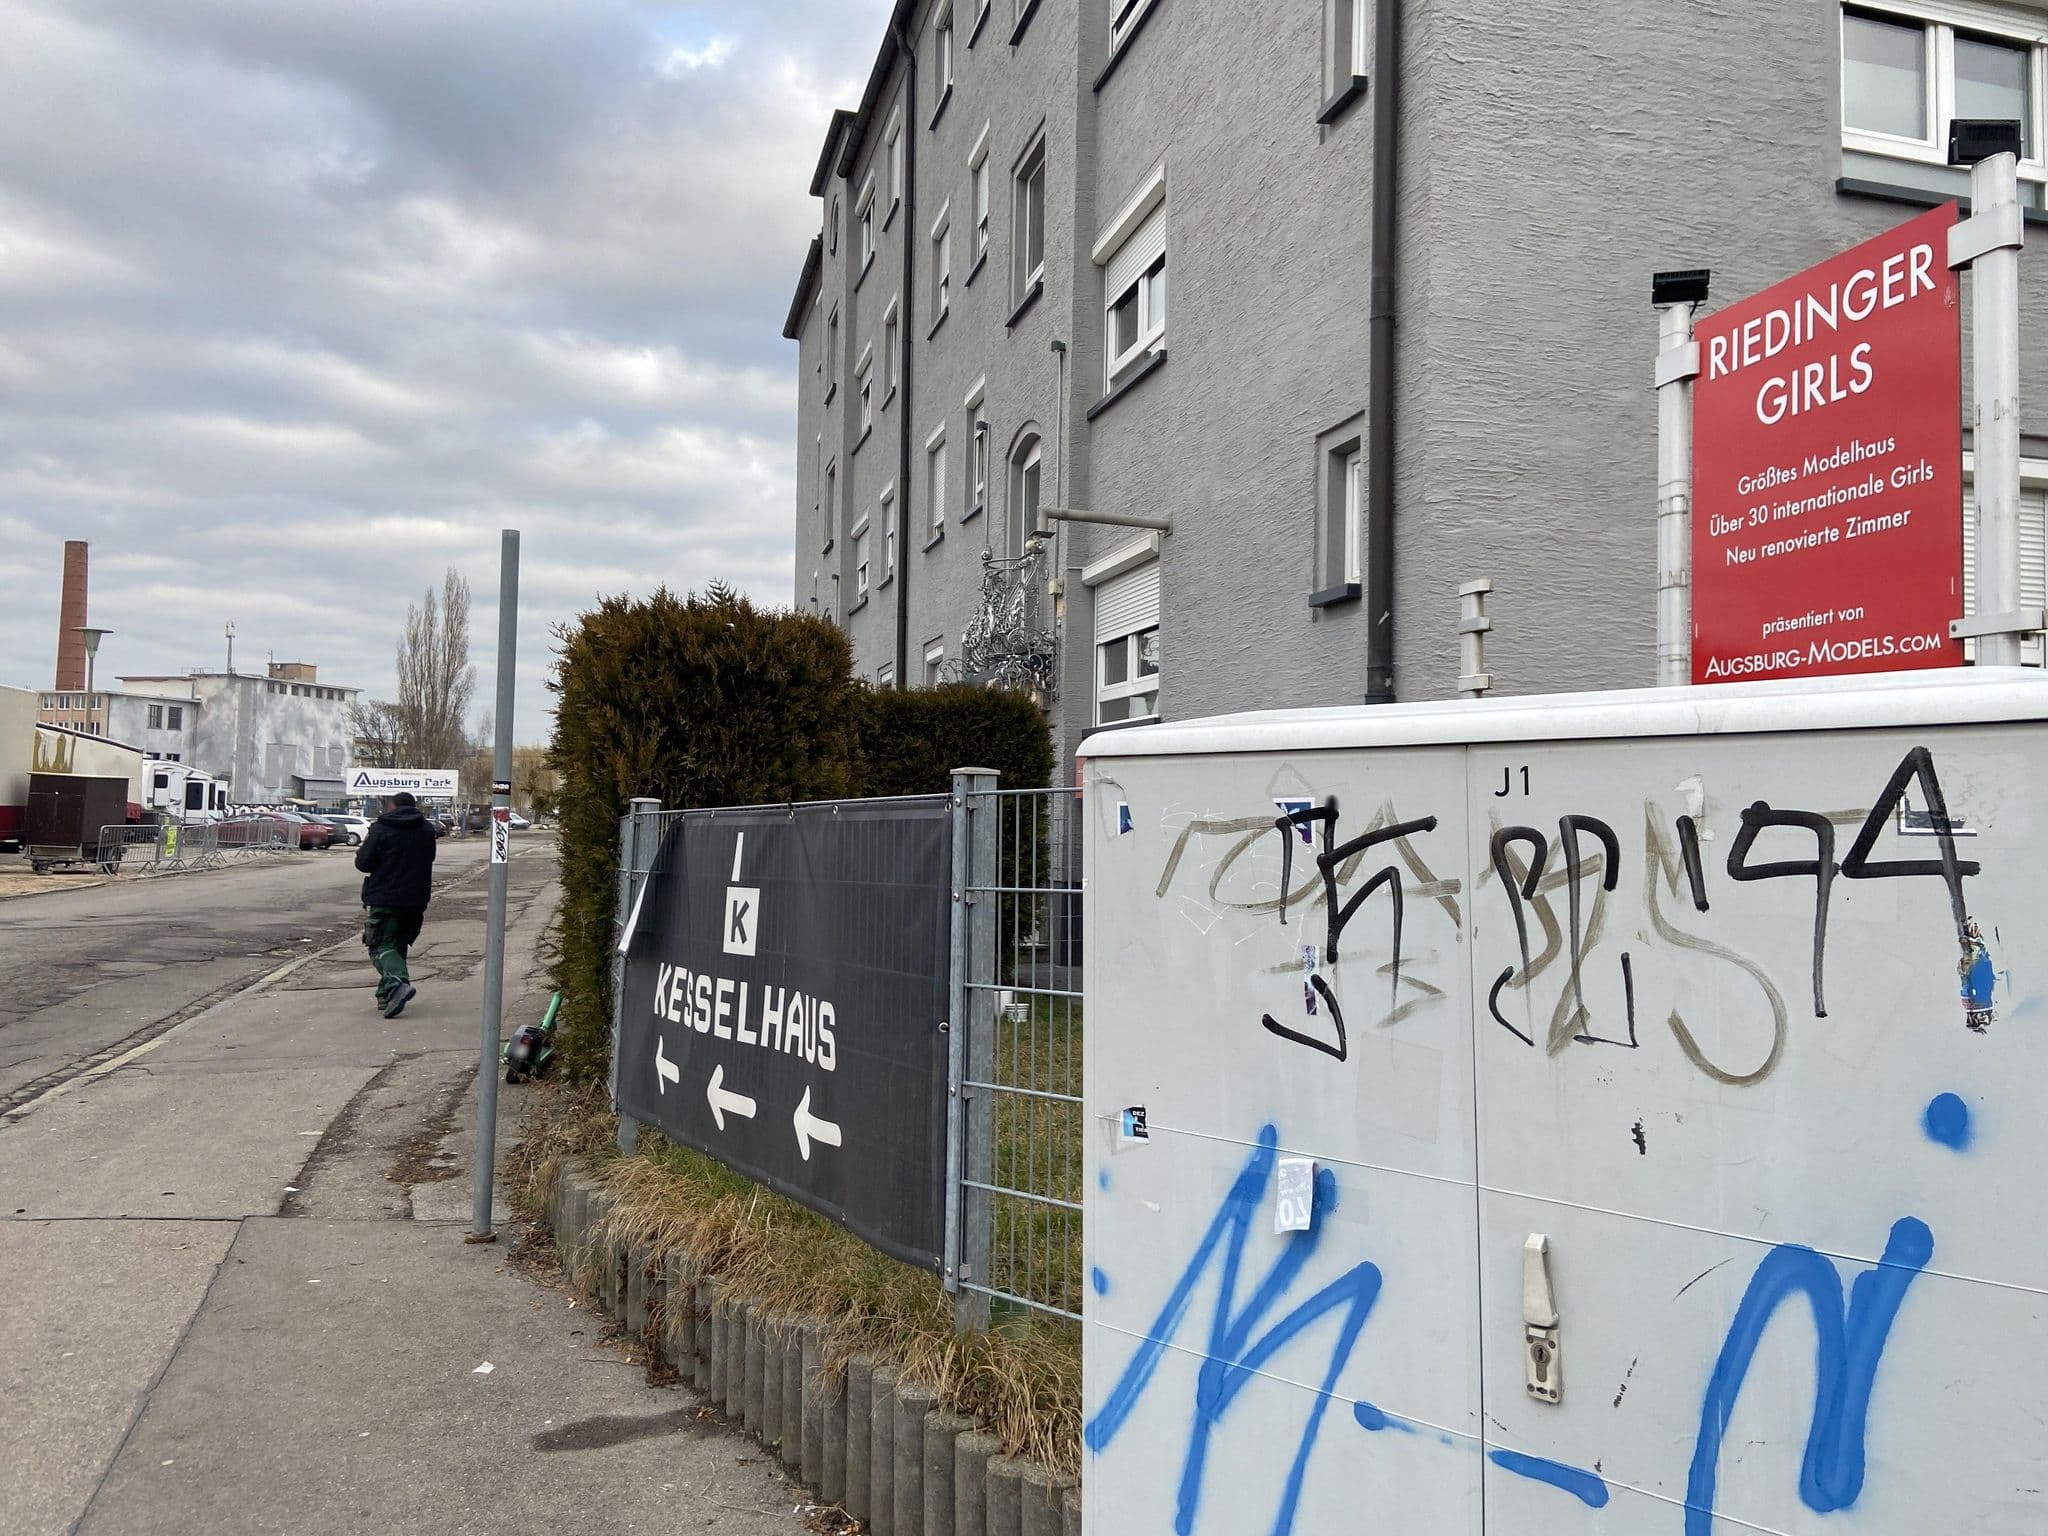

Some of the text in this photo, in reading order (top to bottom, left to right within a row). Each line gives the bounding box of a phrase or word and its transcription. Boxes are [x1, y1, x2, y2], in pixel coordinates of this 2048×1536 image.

[1709, 243, 1936, 381] RIEDINGER
[1756, 342, 1874, 425] GIRLS
[1737, 436, 1896, 496] Größtes Modelhaus
[1709, 458, 1934, 537] Über 30 internationale Girls
[1726, 509, 1912, 566] Neu renovierte Zimmer
[1762, 606, 1865, 640] präsentiert von
[353, 771, 452, 788] Augsburg Park
[730, 899, 750, 944] K
[653, 961, 837, 1072] KESSELHAUS
